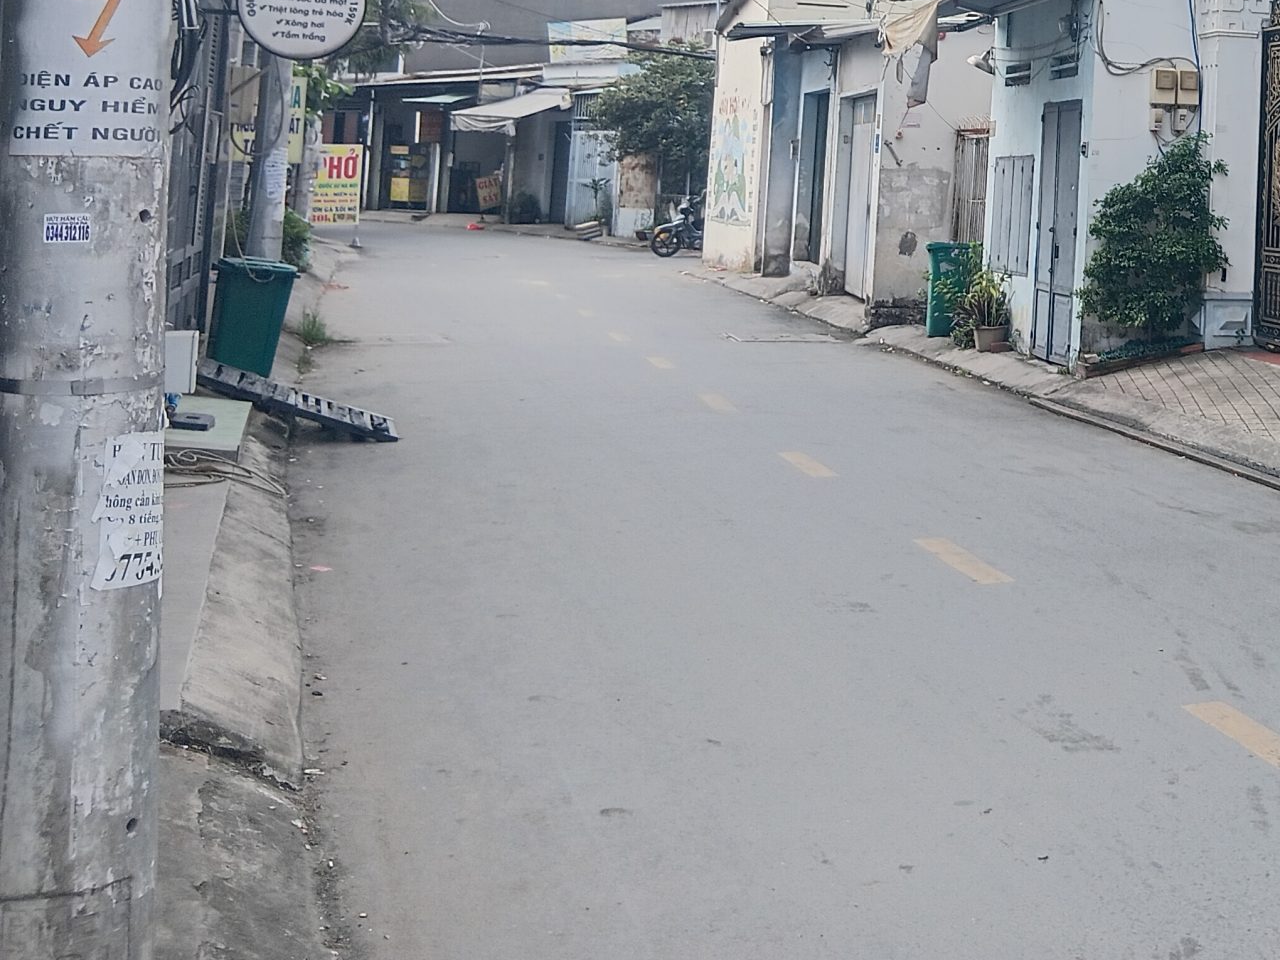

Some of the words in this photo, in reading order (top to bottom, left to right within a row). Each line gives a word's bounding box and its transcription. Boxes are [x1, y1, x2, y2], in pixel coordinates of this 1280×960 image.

[345, 2, 359, 25] 159K
[83, 72, 119, 88] ÁP
[129, 76, 163, 91] CAO
[13, 121, 79, 140] CHẾT
[323, 148, 359, 179] HỞ
[104, 494, 132, 511] hông
[128, 514, 136, 524] 8
